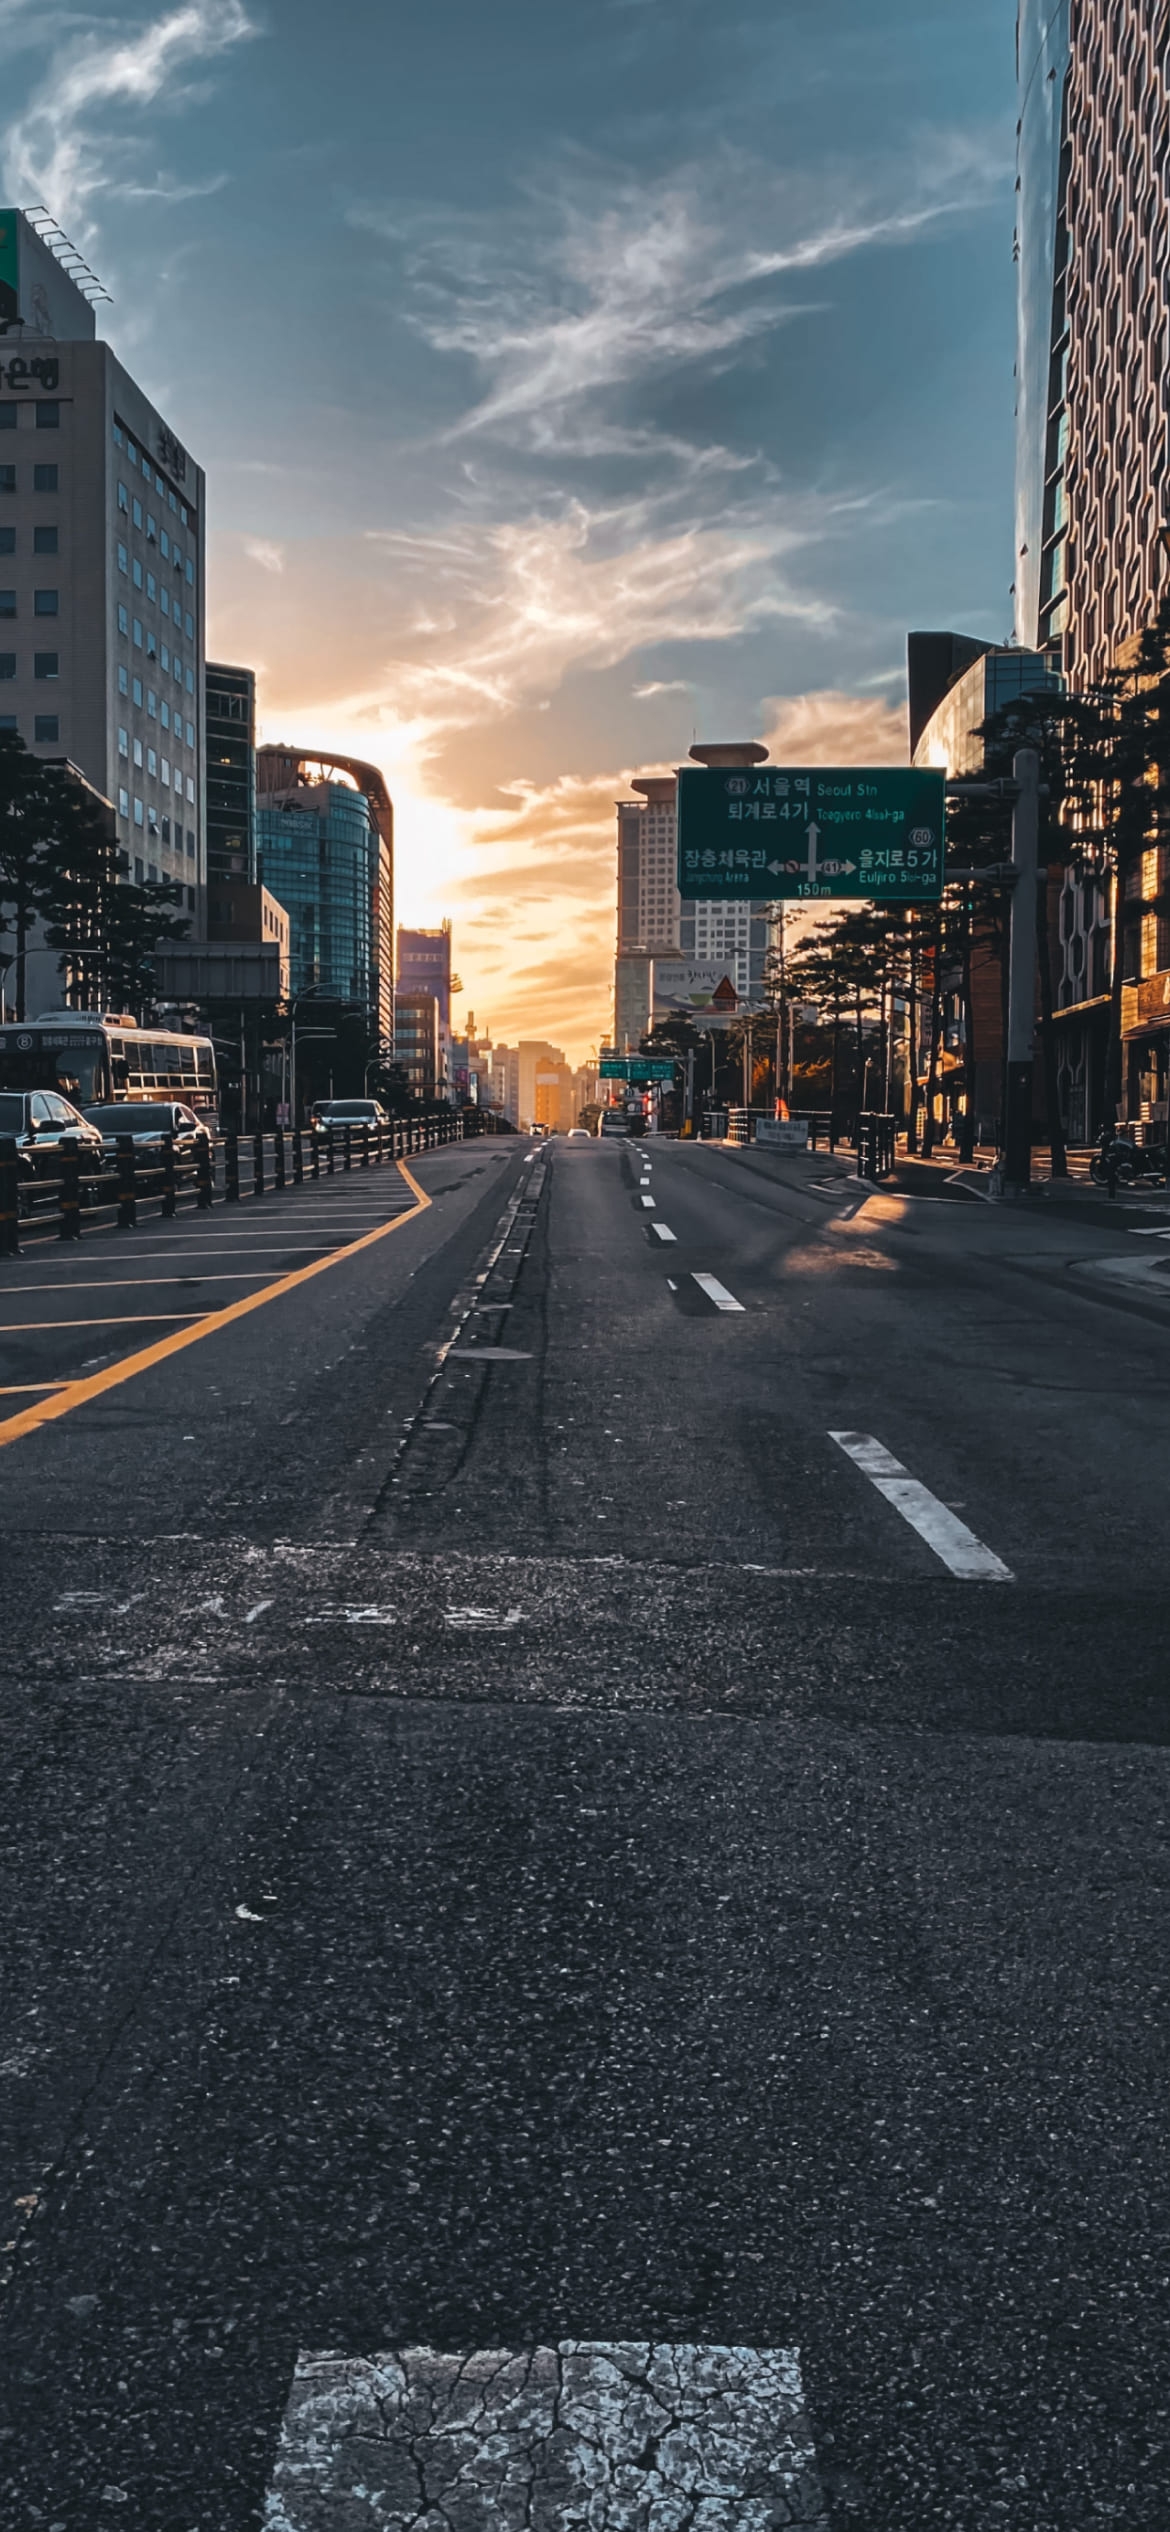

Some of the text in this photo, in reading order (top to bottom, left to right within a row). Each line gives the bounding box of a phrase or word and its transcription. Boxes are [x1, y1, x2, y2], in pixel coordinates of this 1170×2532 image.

[0, 358, 59, 390] 은행
[752, 777, 811, 797] 서울역
[817, 783, 852, 797] Seoul
[856, 783, 878, 797] Stn
[728, 801, 809, 821] 퇴계로4가
[816, 807, 862, 824] Toegyero
[684, 849, 768, 869] 장충체육관
[725, 871, 750, 883] Arena
[858, 870, 897, 886] Euljiro
[797, 883, 832, 896] 150m
